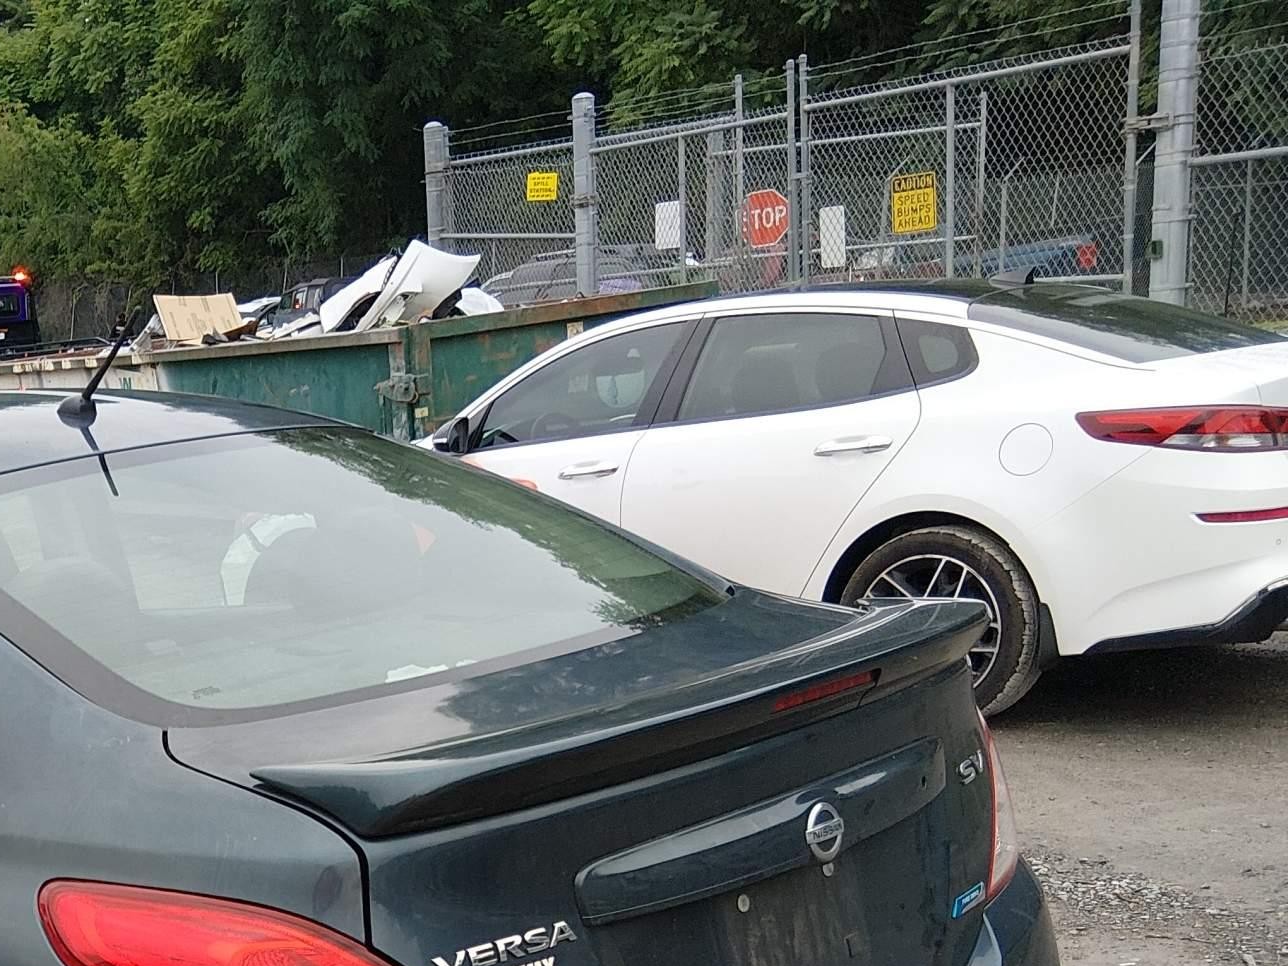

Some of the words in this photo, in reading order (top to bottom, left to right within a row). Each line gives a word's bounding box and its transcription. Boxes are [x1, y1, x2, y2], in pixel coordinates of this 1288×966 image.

[894, 175, 933, 191] CAUTION
[897, 191, 930, 206] SPEED
[743, 205, 787, 230] TOP
[897, 203, 931, 218] BUMPS
[898, 214, 930, 229] AHEAD
[959, 750, 983, 784] SV
